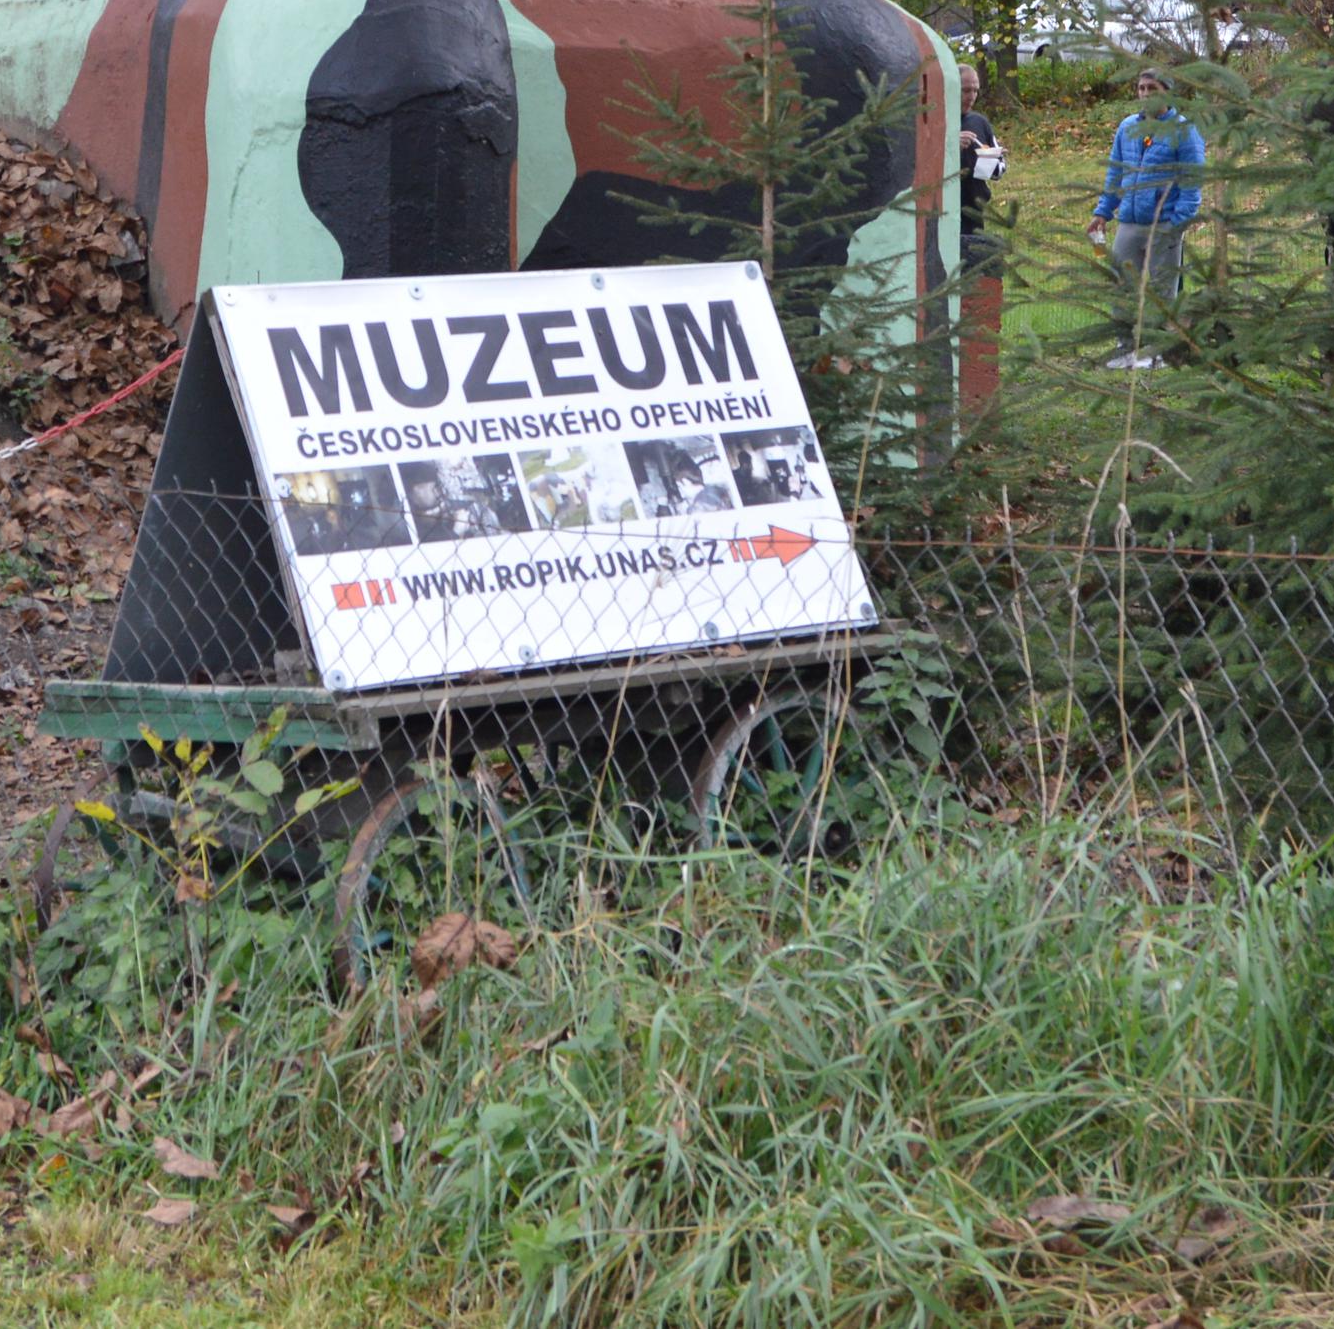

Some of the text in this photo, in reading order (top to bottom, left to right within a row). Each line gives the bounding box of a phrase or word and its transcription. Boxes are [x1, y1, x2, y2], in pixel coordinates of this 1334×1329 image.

[266, 299, 760, 418] MUZEUM
[296, 389, 772, 460] ČESKOSLOVENSKÉHO OPEVNĚNÍ
[401, 537, 724, 602] WWW.ROPIK.UNAS.CZ
